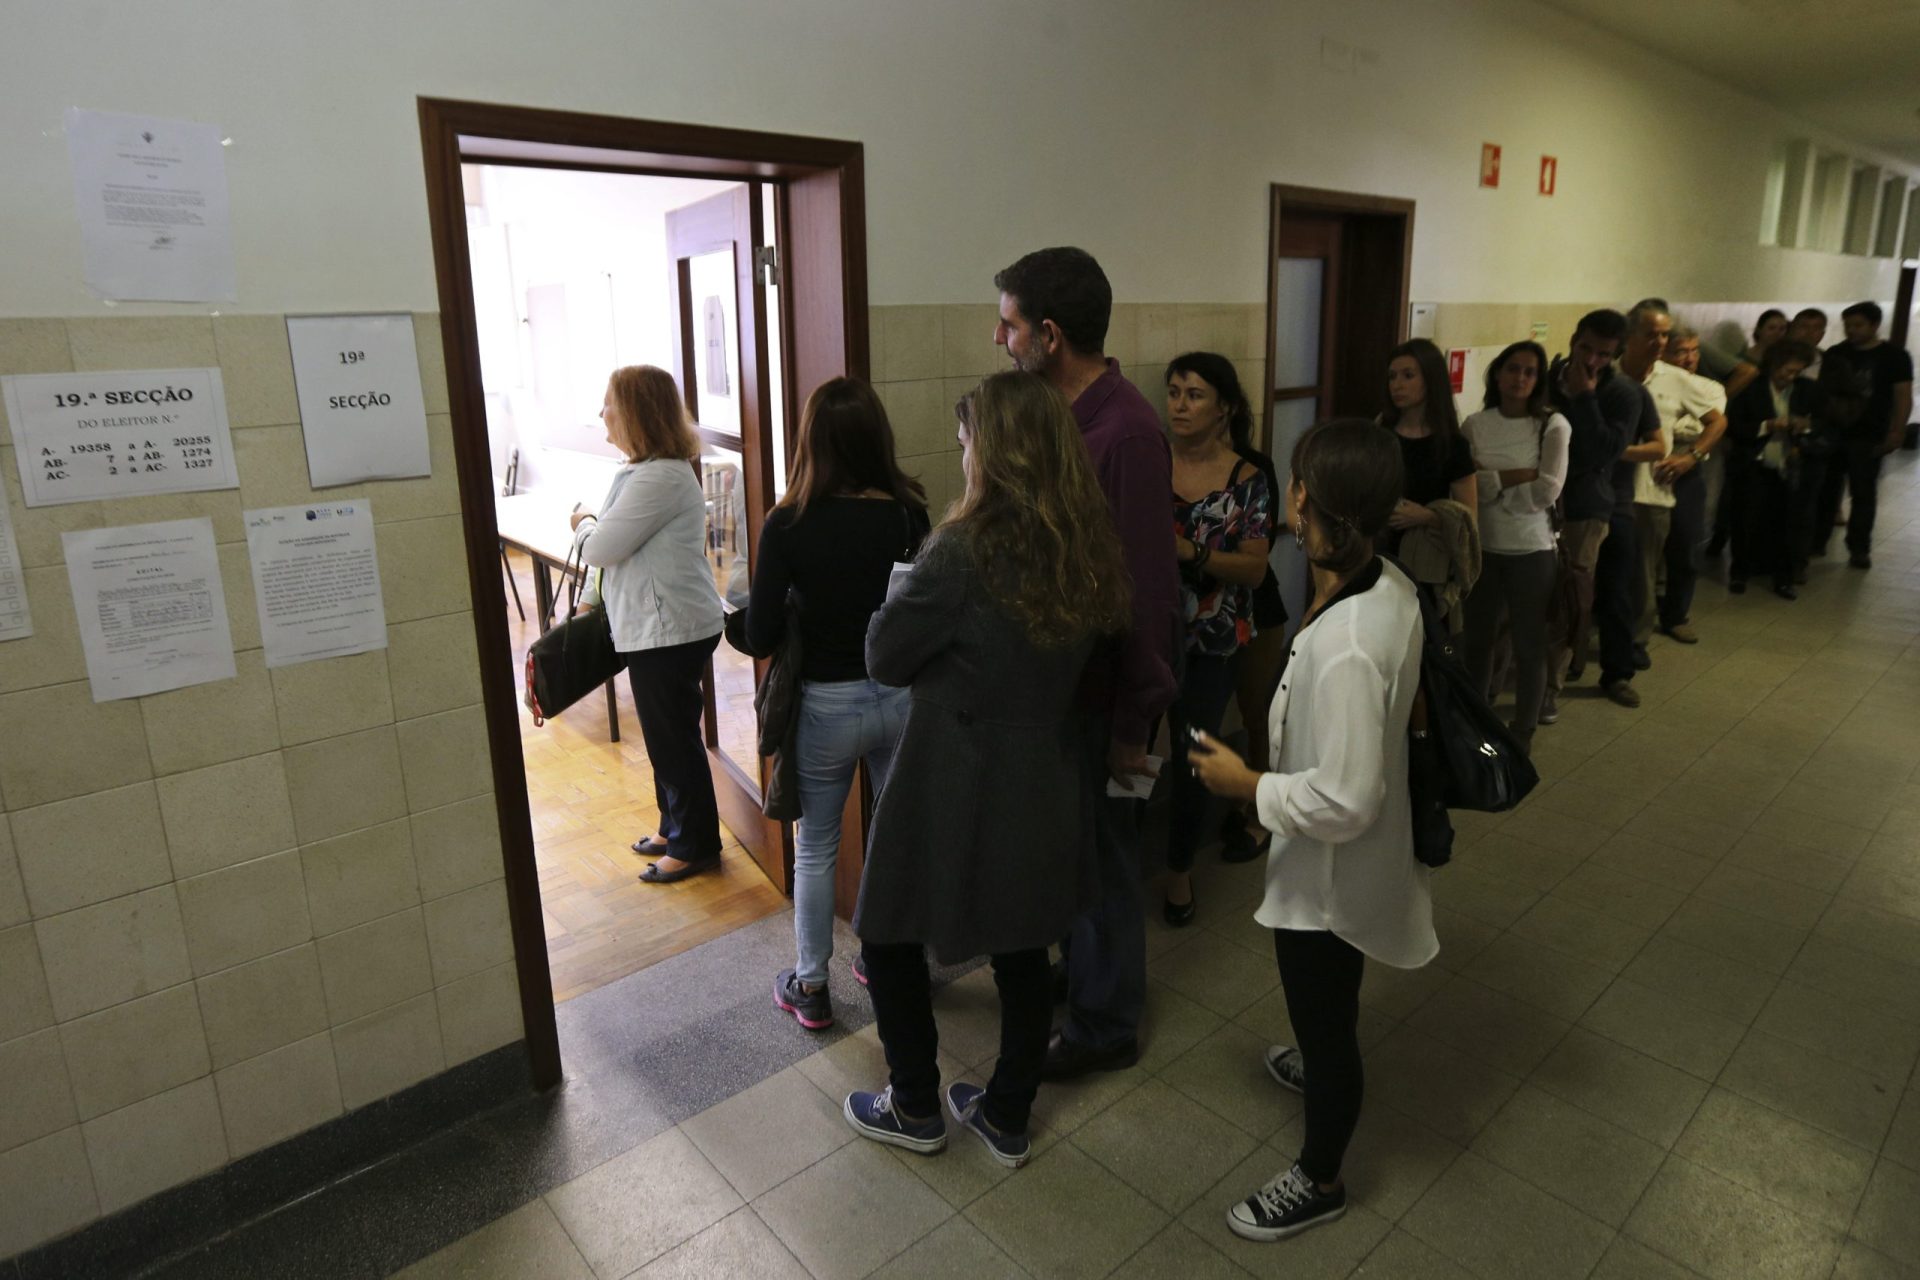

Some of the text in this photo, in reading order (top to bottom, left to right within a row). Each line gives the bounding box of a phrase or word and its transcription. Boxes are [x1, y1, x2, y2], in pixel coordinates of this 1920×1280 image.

[103, 385, 194, 407] SECÇÃO
[329, 391, 392, 410] SECÇÃO
[77, 418, 99, 430] DO
[101, 415, 159, 429] ELEITOR
[40, 446, 56, 457] A-
[69, 442, 113, 455] 19358
[172, 435, 212, 447] 20255
[43, 447, 212, 469] AB- 7 a AB- 1274
[46, 458, 214, 482] AC- 2 a AC- 1327
